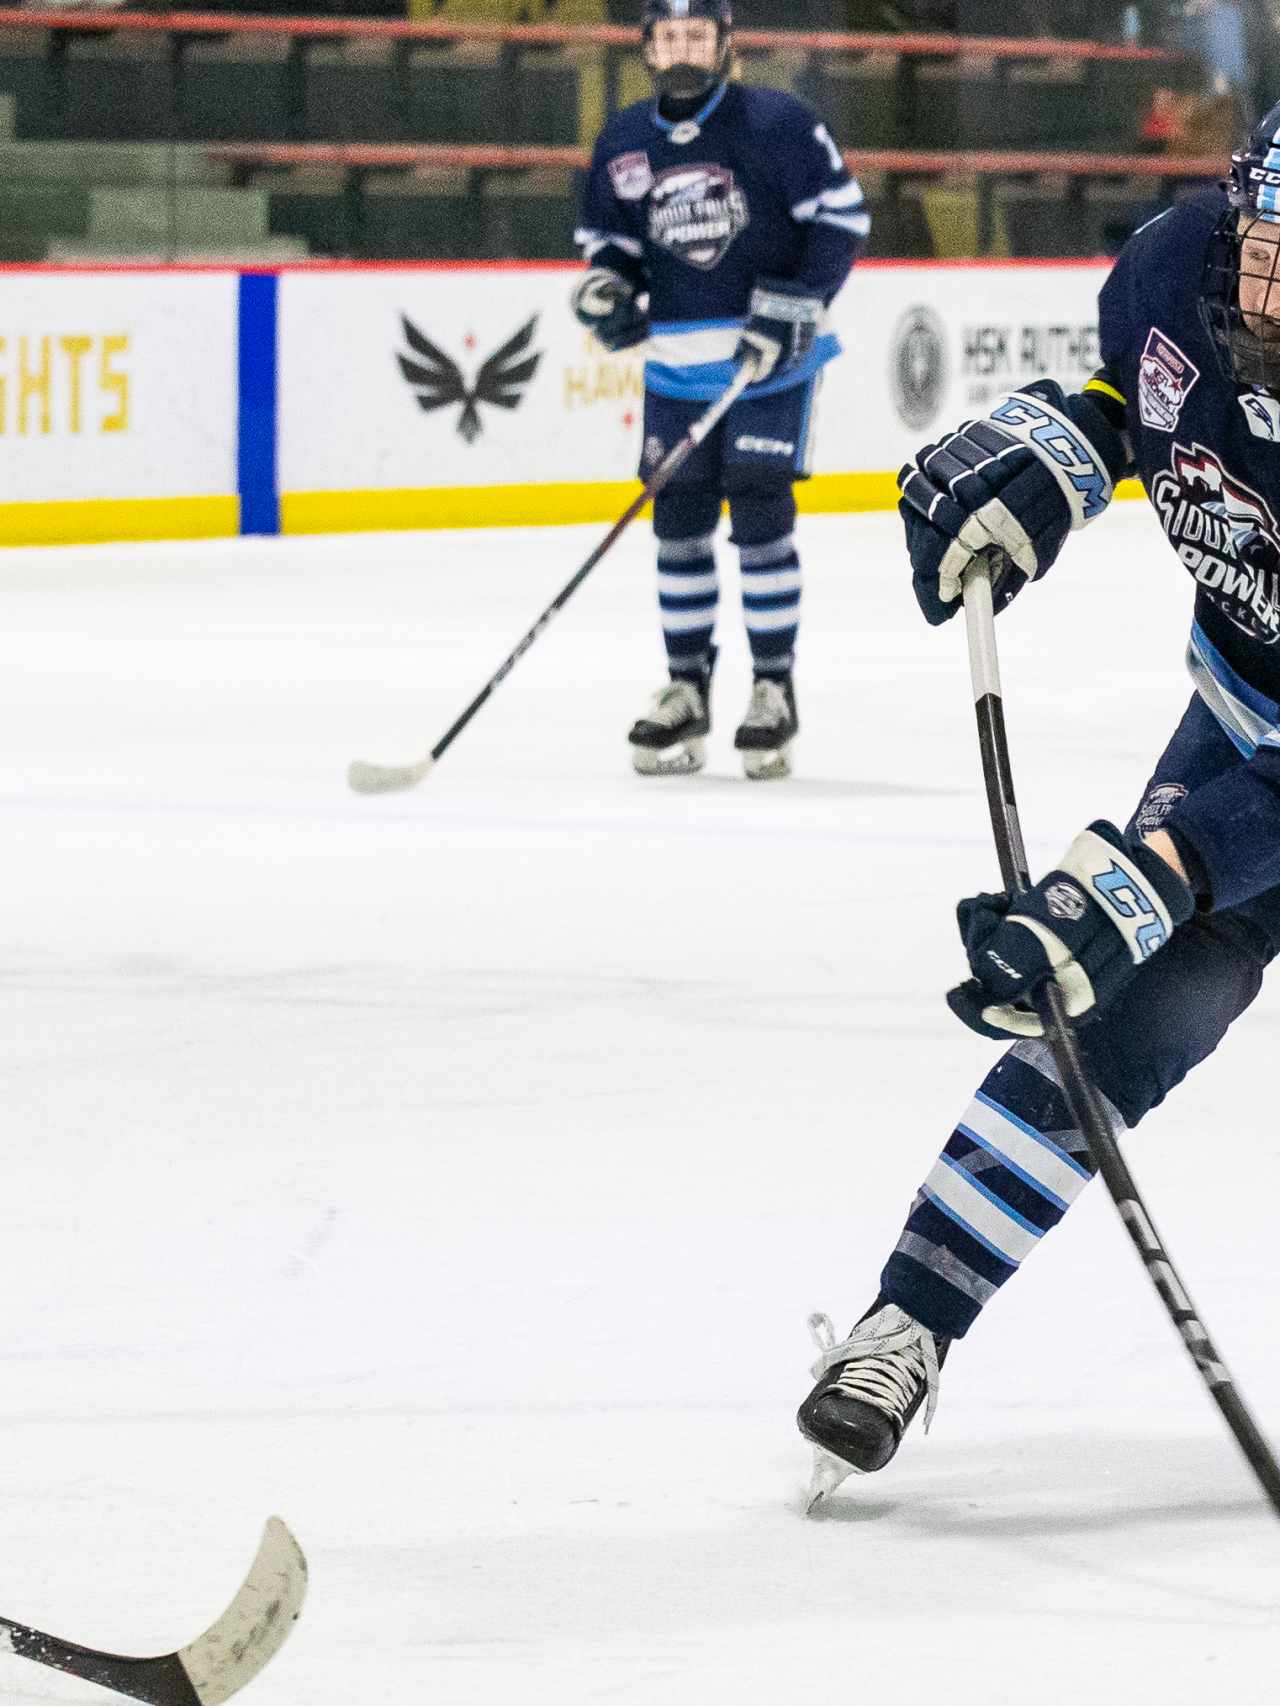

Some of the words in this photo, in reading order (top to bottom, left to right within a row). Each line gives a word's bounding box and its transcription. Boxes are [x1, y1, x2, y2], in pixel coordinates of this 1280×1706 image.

[0, 334, 129, 436] HTS
[989, 397, 1109, 519] CCM
[1157, 480, 1237, 560] SIOUX
[1177, 543, 1280, 633] POWER
